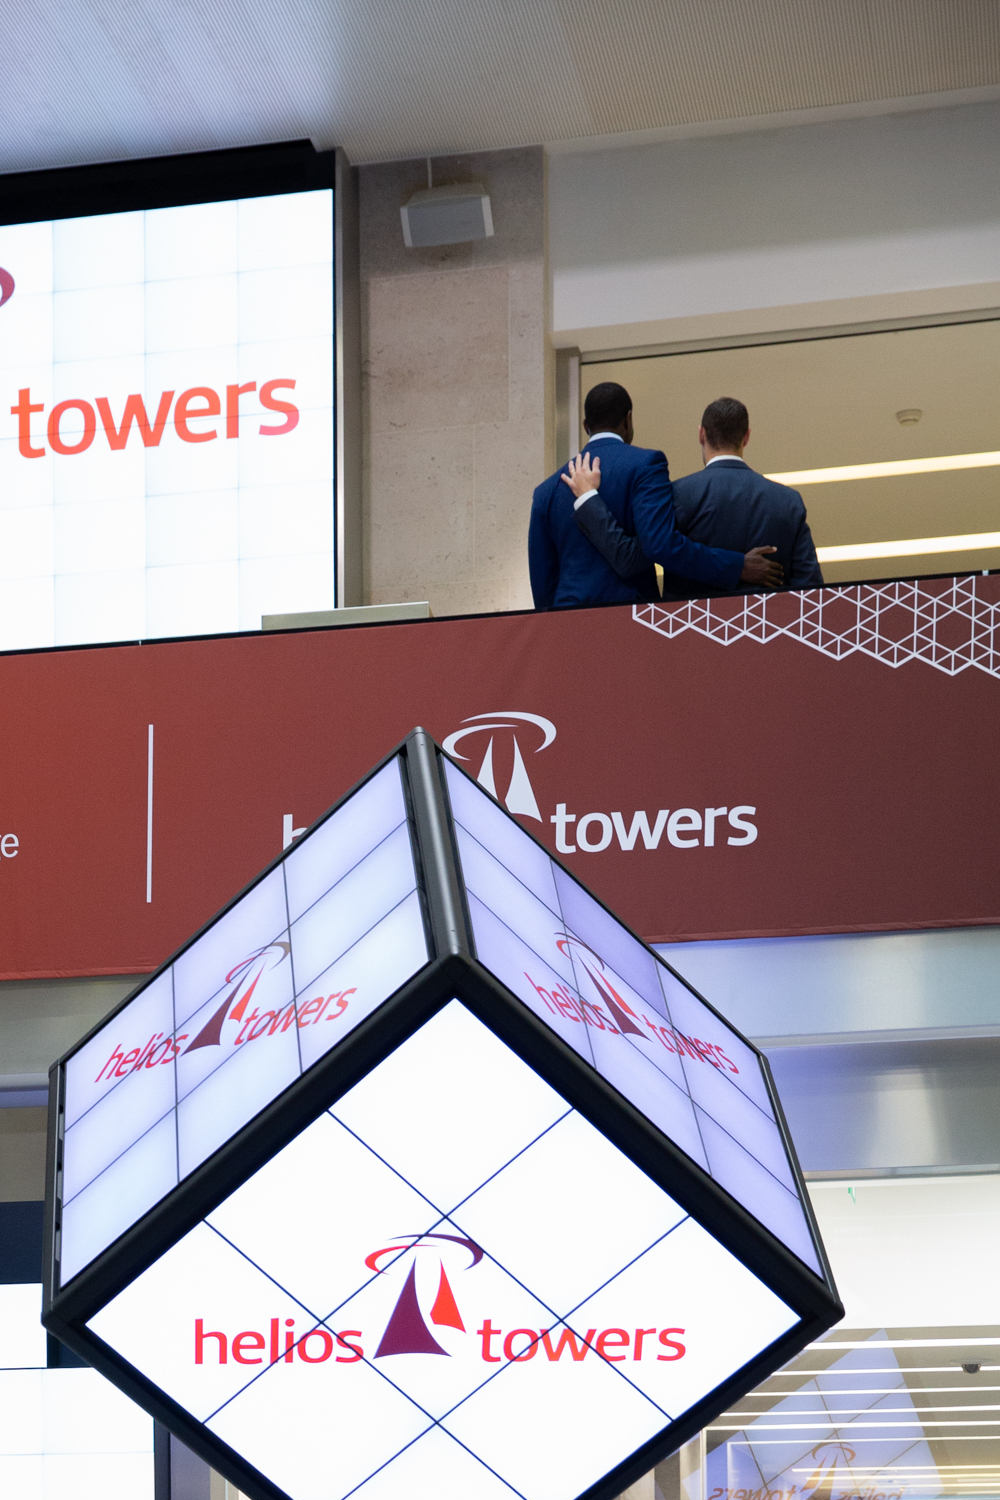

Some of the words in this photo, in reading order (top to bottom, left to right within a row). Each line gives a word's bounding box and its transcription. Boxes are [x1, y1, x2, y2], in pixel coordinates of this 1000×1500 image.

[10, 378, 300, 459] towers
[550, 803, 758, 854] towers
[94, 1032, 190, 1083] helios
[233, 987, 358, 1046] towers
[523, 971, 620, 1035] helios
[641, 1013, 740, 1075] towers
[194, 1318, 365, 1365] helios
[476, 1318, 687, 1363] towers
